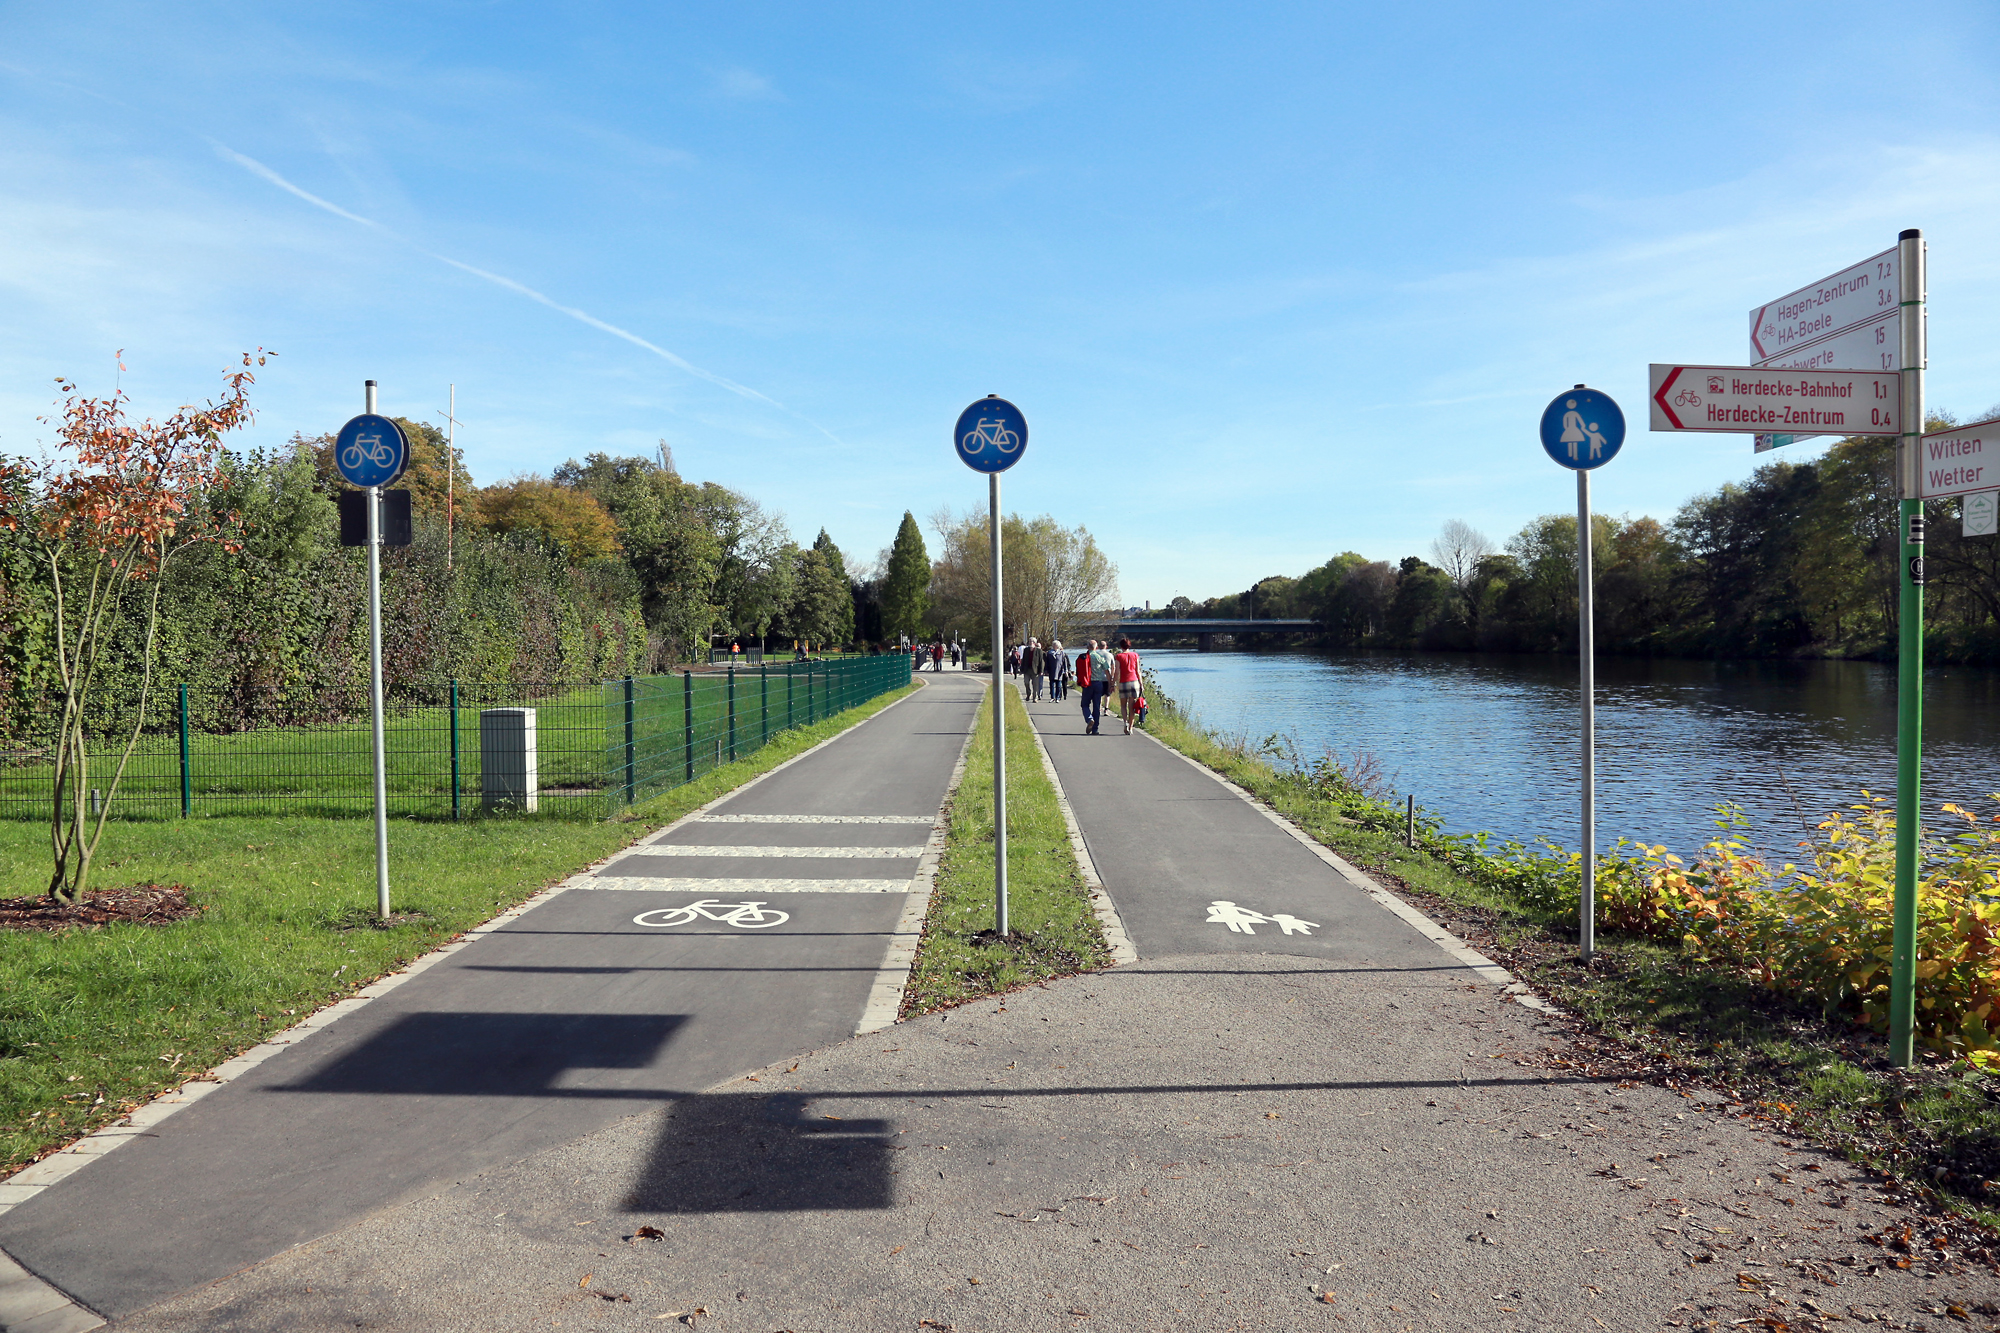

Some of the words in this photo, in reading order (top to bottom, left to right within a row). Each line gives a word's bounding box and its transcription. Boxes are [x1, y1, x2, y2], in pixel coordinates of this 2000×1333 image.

[1778, 273, 1869, 322] Hagen-Zentrum
[1877, 262, 1892, 281] 7,2
[1778, 313, 1832, 345] HA-Boele
[1878, 288, 1892, 306] 3,6
[1874, 326, 1885, 345] 15
[1880, 352, 1892, 371] 1,7
[1732, 378, 1853, 398] Herdecke-Bahnhof
[1873, 380, 1887, 399] 1,1
[1707, 403, 1845, 425] Herdecke-Zentrum
[1871, 408, 1891, 426] 0,4
[1929, 438, 1982, 461] Witten
[1929, 467, 1984, 488] Wetter
